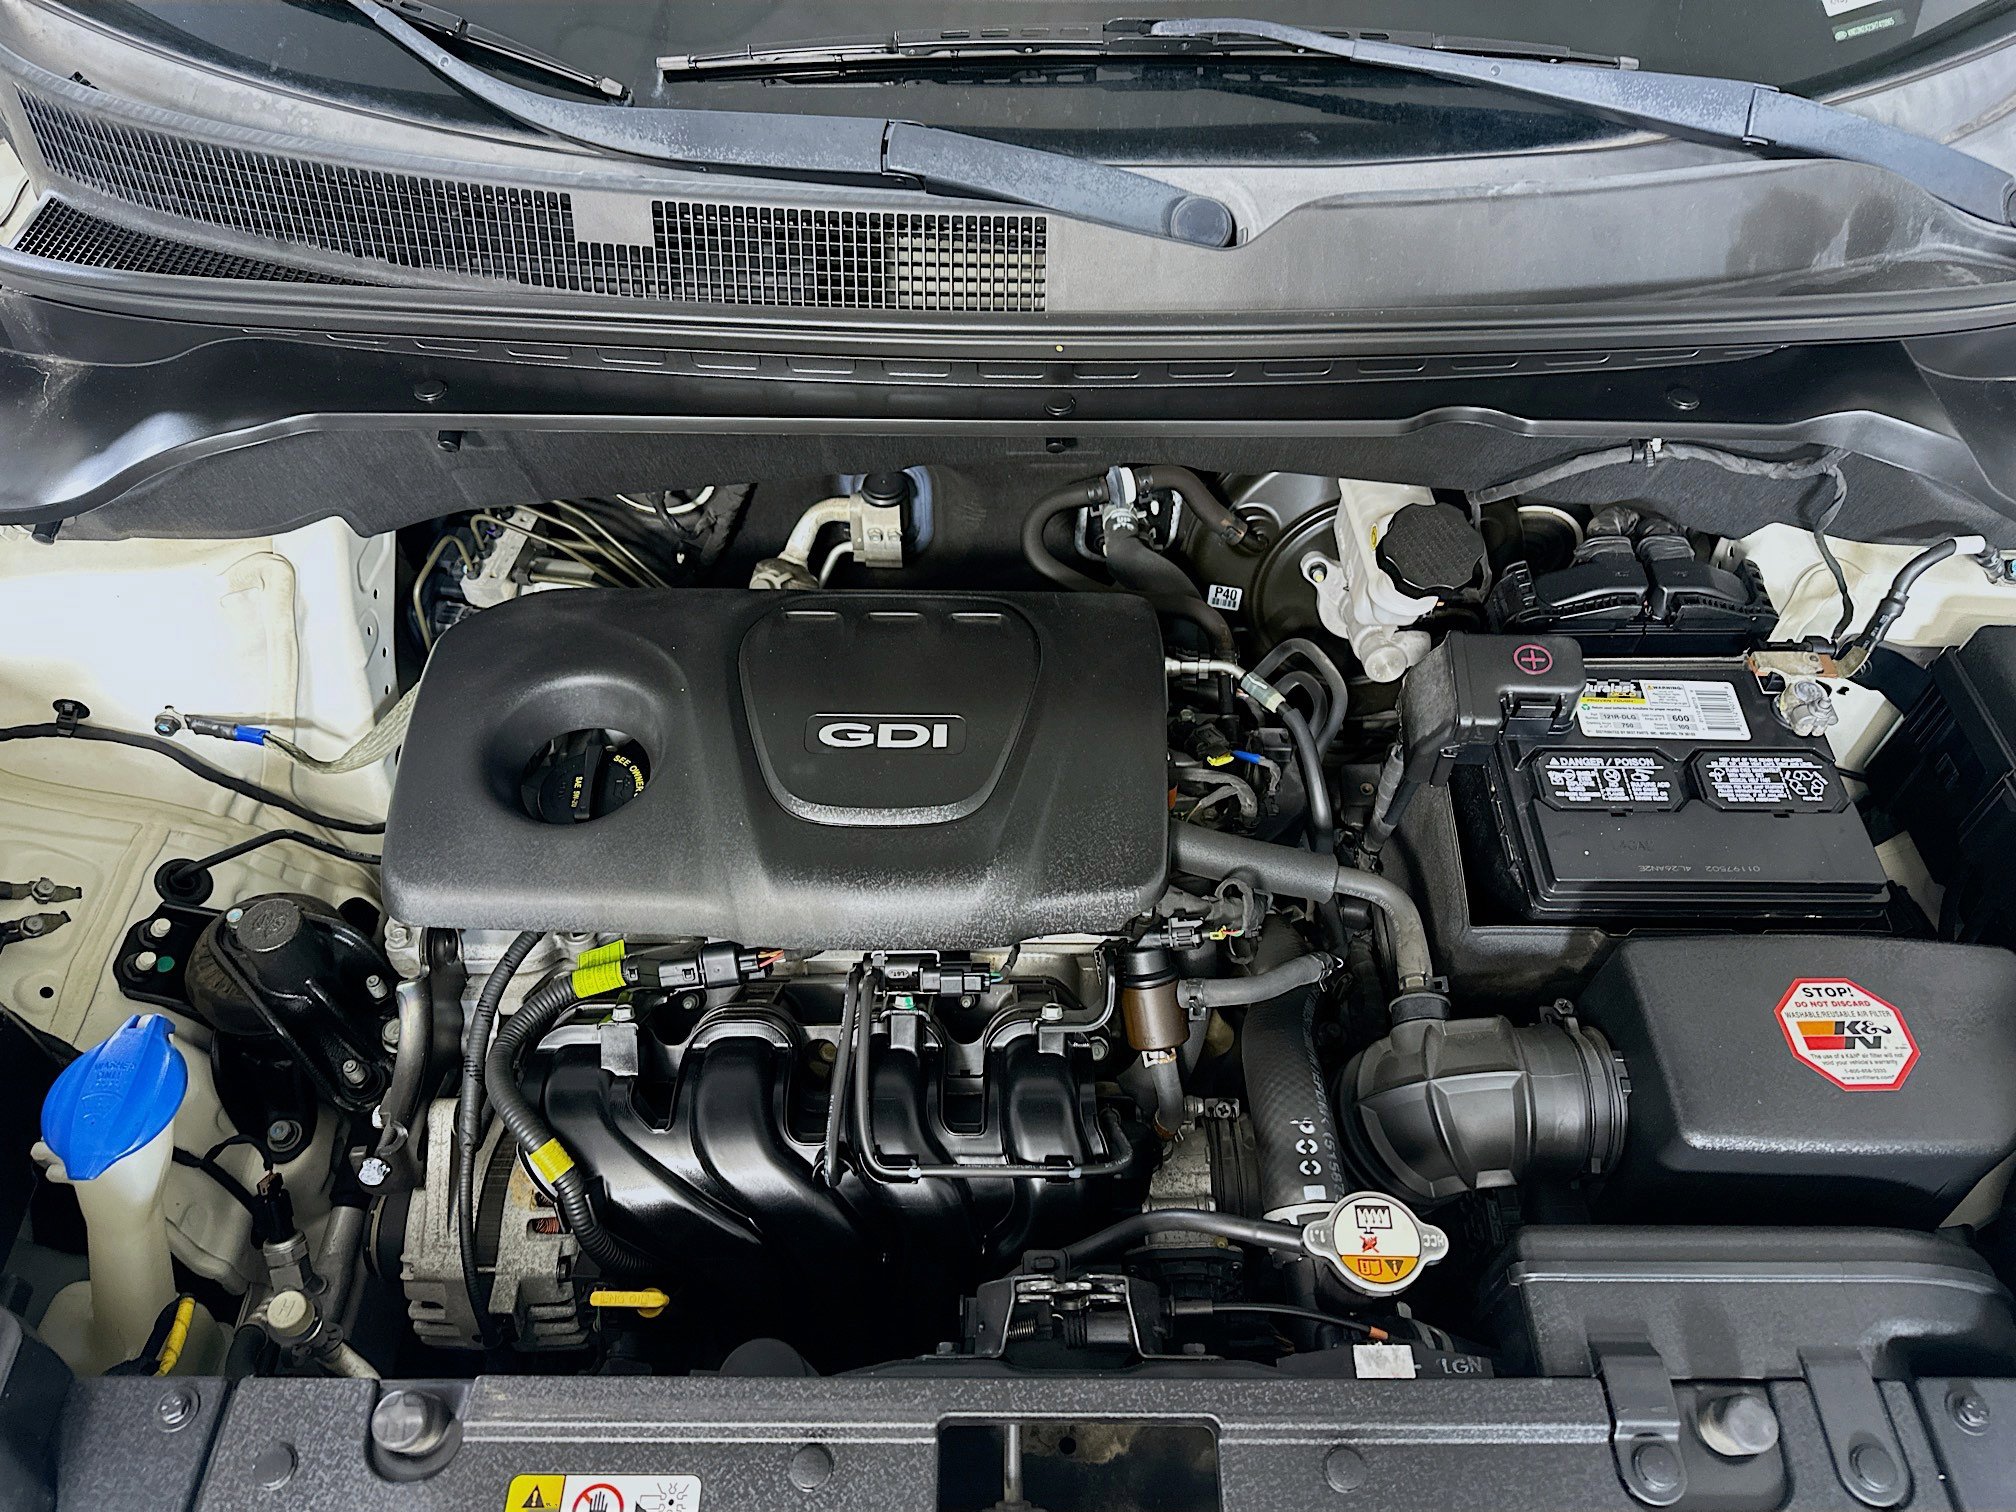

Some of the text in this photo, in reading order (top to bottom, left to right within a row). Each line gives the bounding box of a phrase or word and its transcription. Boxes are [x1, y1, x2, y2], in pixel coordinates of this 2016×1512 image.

[1215, 587, 1237, 601] P40
[1672, 714, 1690, 722] 600
[818, 722, 948, 749] GDI
[613, 754, 632, 767] SEE
[1560, 757, 1605, 766] DANGER
[1614, 757, 1655, 766] POISON
[1802, 987, 1854, 998] STOP!
[1784, 1010, 1892, 1019] WASHABLE/REUSABLE AIR FILTER
